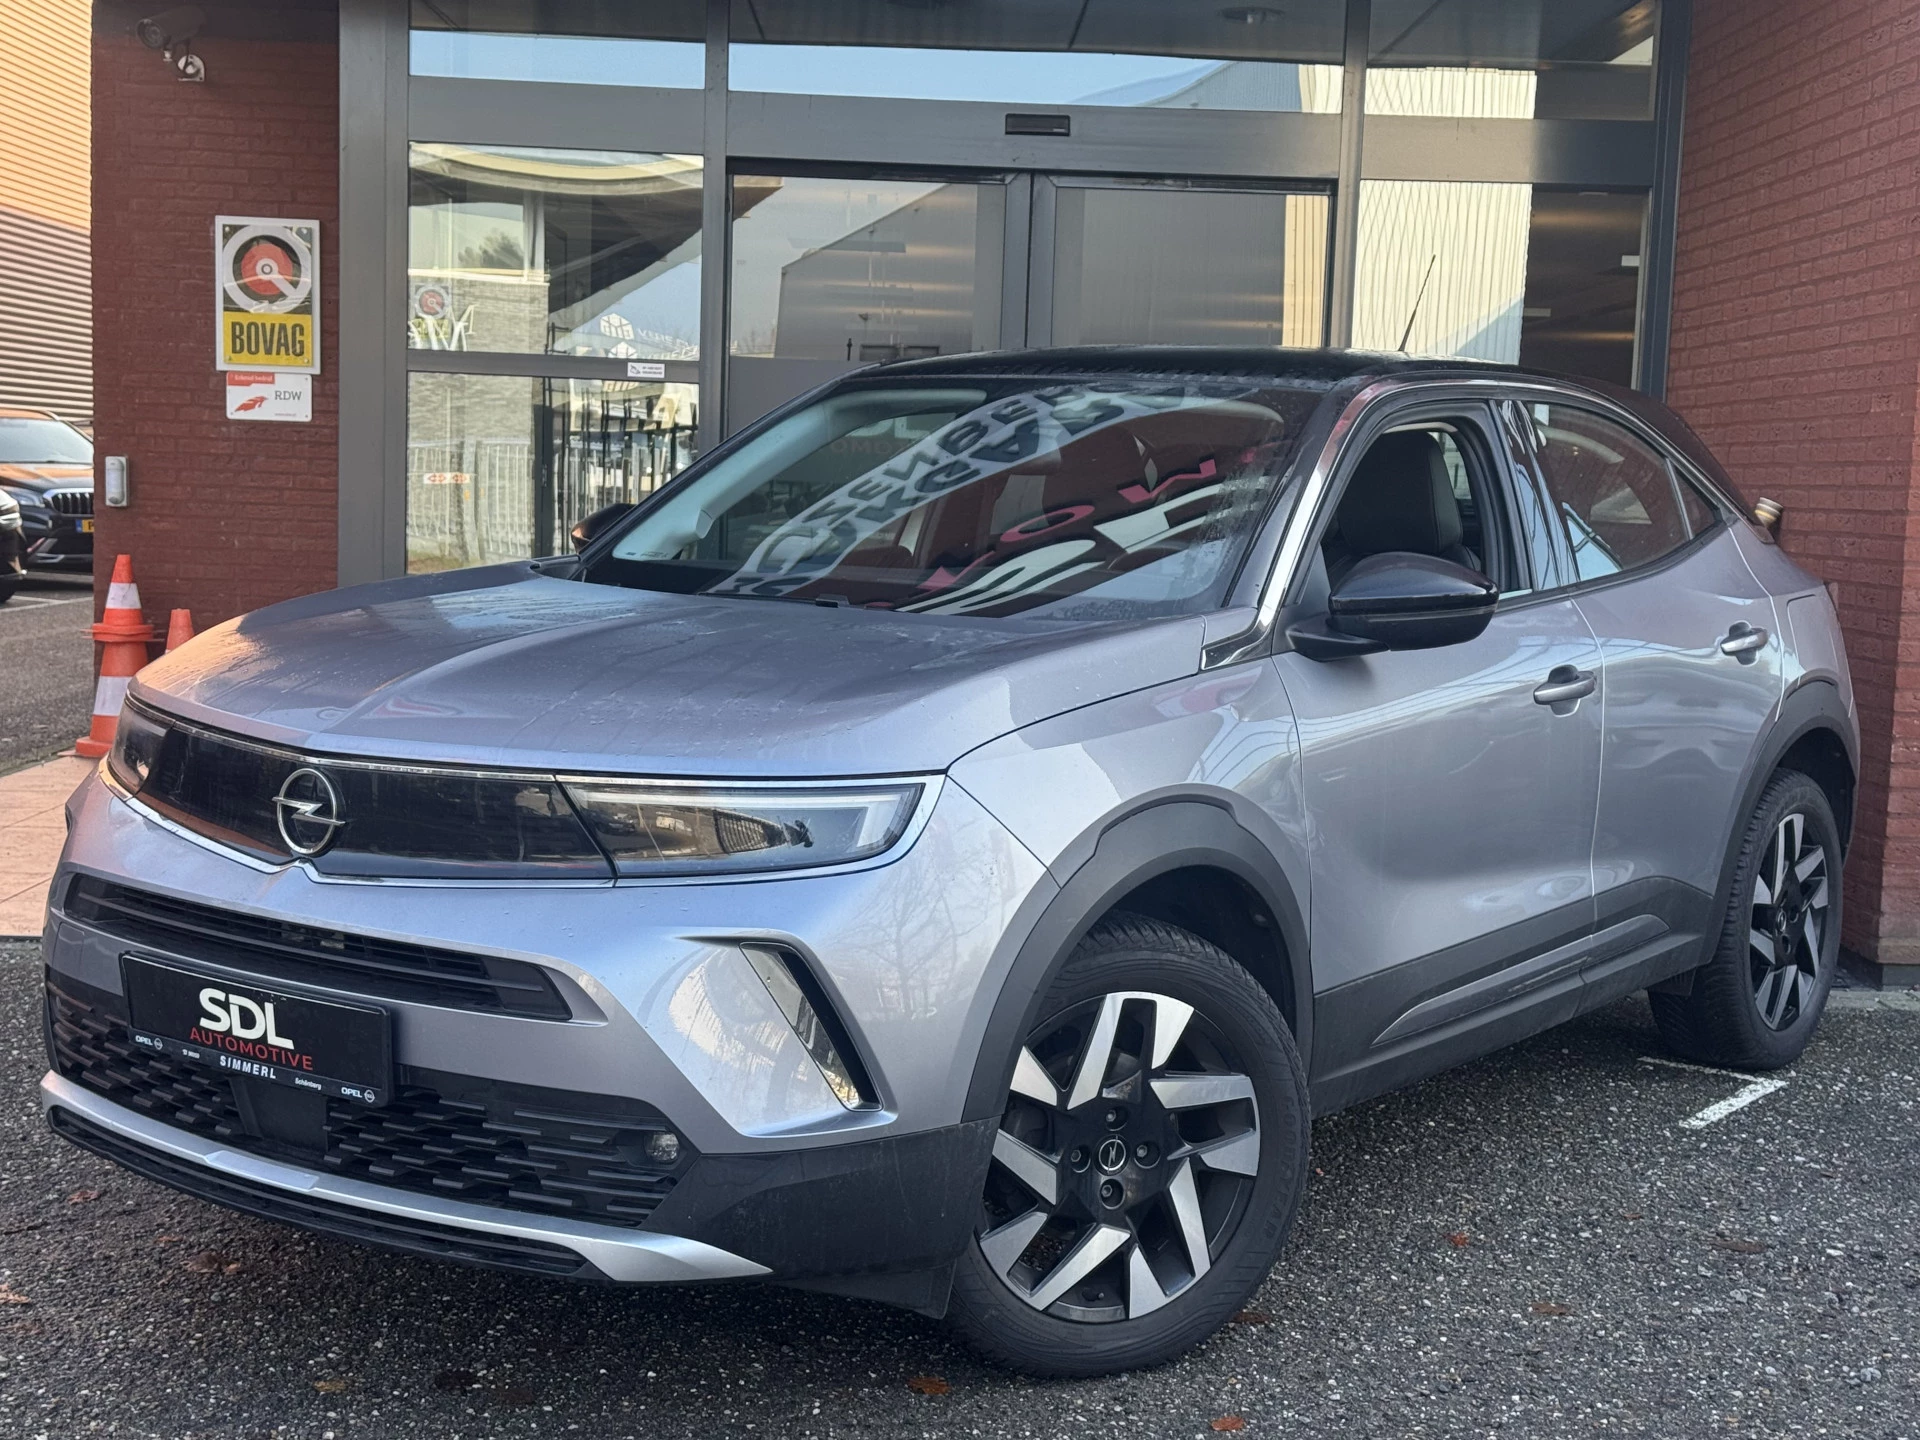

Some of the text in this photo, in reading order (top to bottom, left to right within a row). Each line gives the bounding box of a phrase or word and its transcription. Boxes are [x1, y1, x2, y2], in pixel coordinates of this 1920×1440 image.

[231, 321, 305, 357] BOVAG
[274, 390, 302, 401] RDW
[199, 987, 295, 1050] SDL
[135, 1035, 153, 1046] OPEL
[220, 1055, 277, 1079] SIMMERL
[341, 1087, 363, 1099] OPEL
[190, 1026, 314, 1071] AUTOMOTIVE
